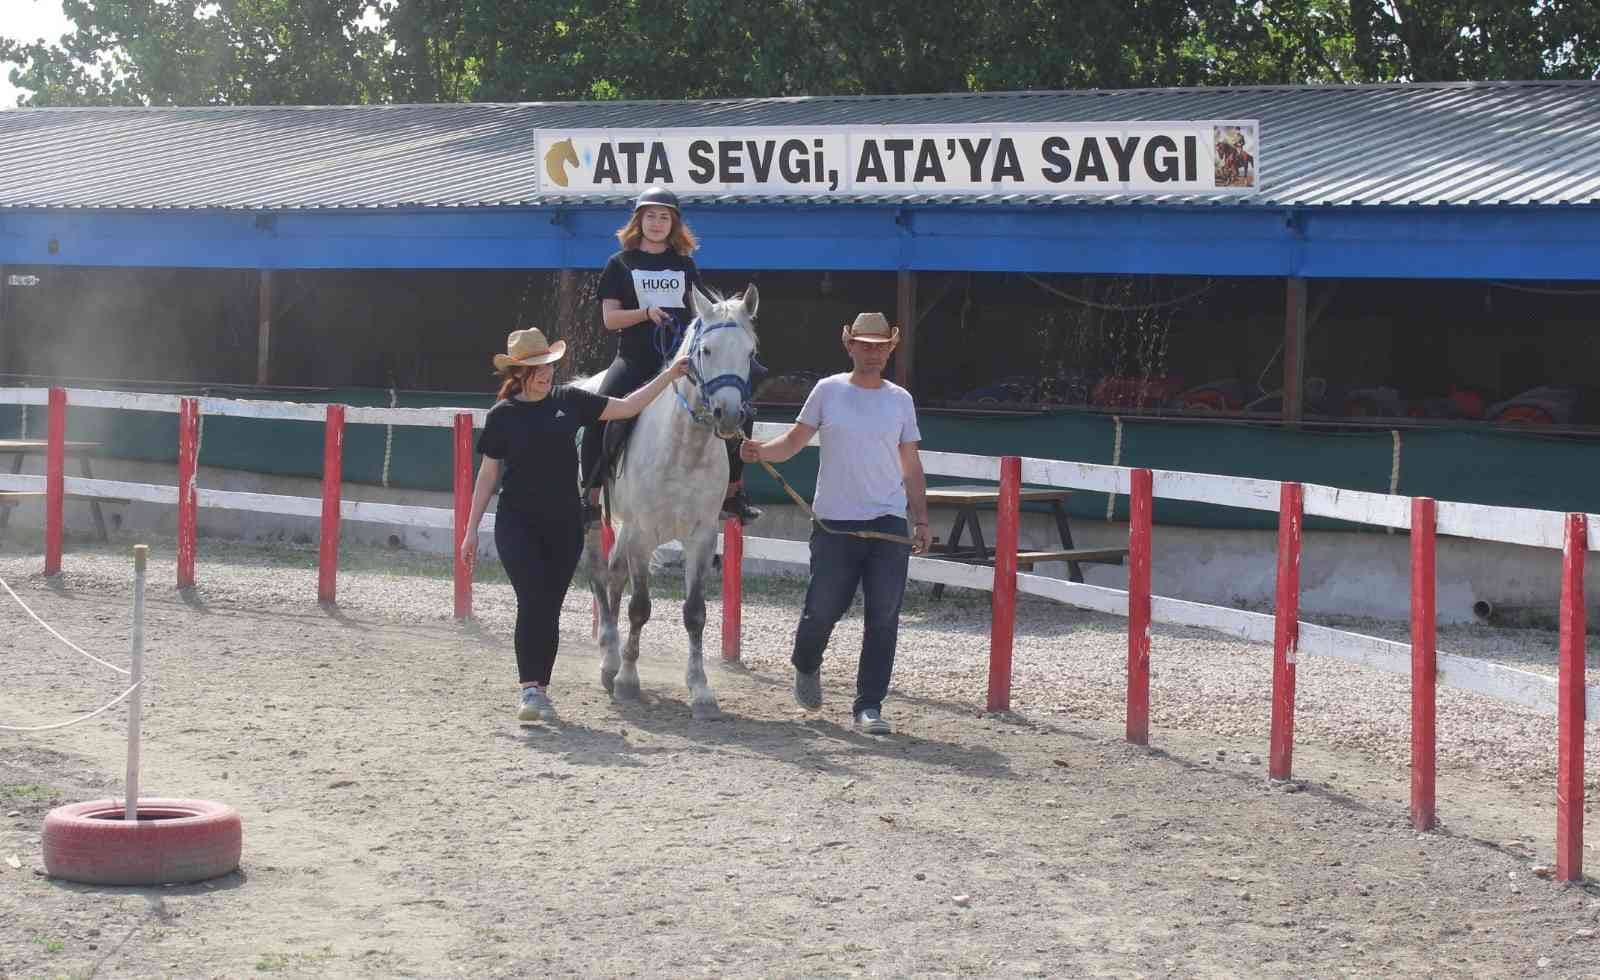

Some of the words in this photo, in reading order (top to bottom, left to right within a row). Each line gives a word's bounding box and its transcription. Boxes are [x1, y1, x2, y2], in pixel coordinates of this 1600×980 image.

[592, 141, 674, 184] ATA
[855, 137, 1025, 183] ATA'YA
[1040, 135, 1197, 183] SAYGI
[642, 279, 680, 289] HUGO
